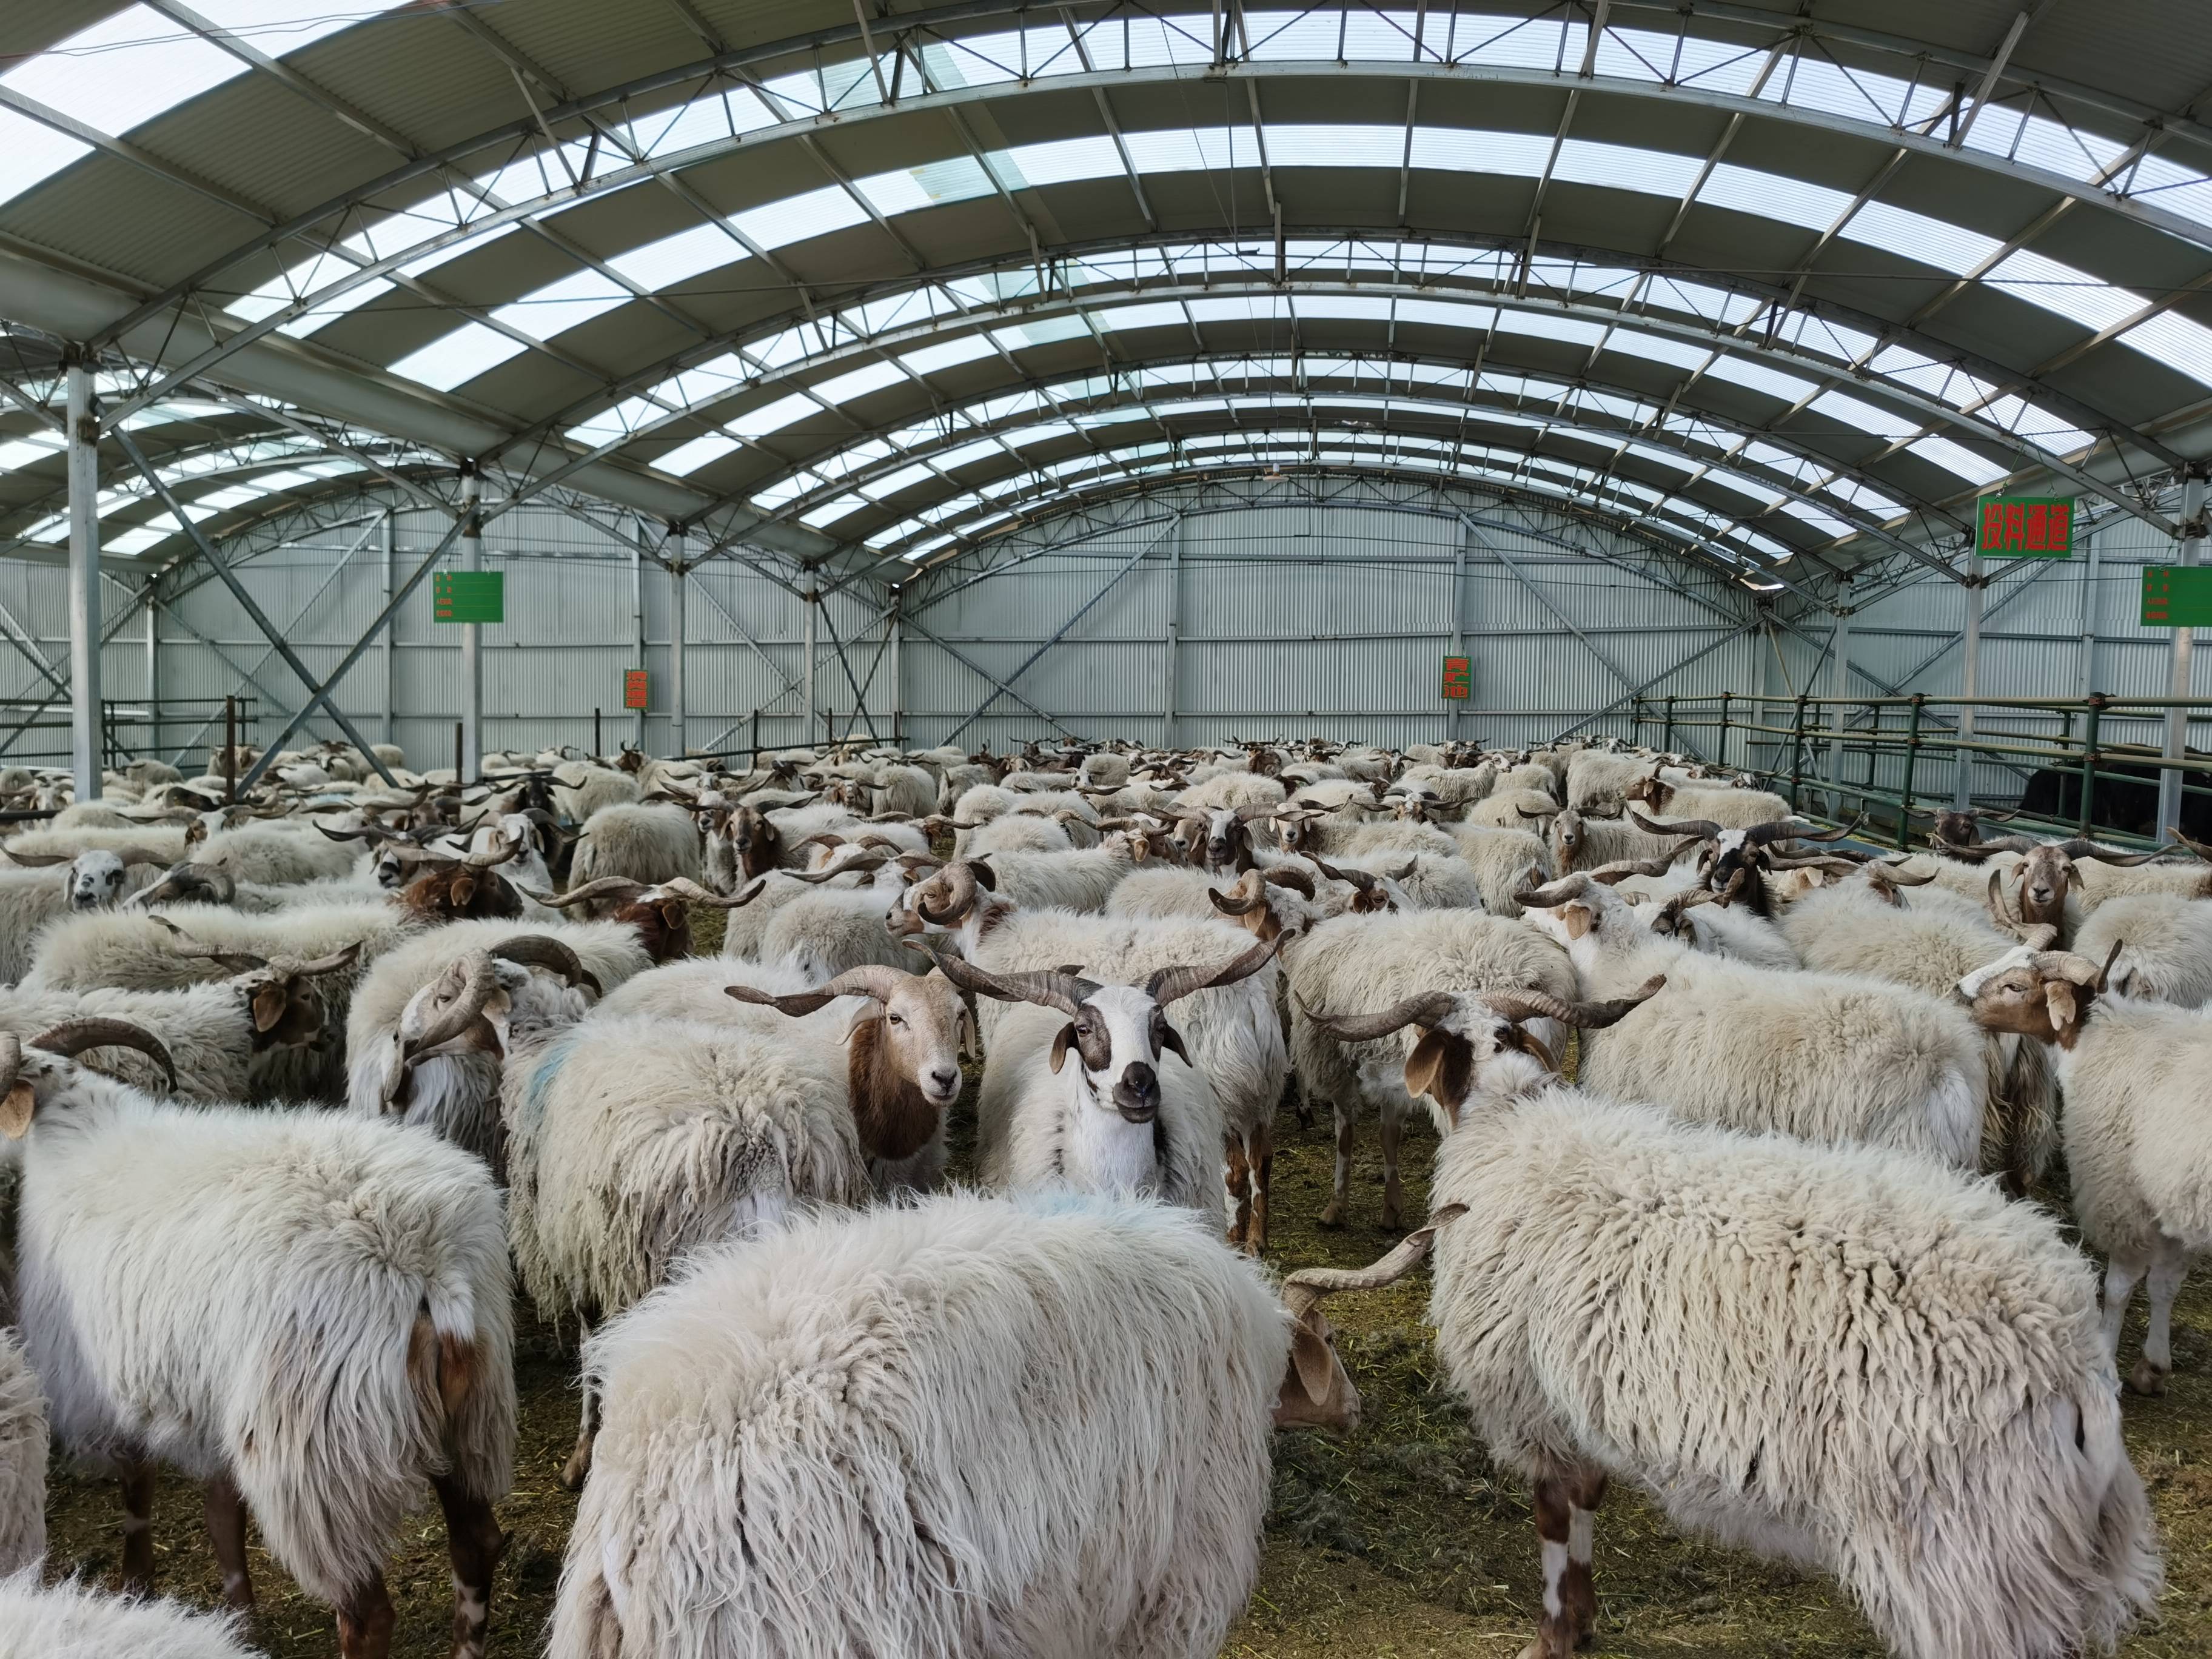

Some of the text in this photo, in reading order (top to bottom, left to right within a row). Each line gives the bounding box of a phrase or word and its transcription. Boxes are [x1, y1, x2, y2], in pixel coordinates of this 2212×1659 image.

[1982, 503, 2070, 551] 投料通道
[1443, 659, 1469, 697] 青贮池
